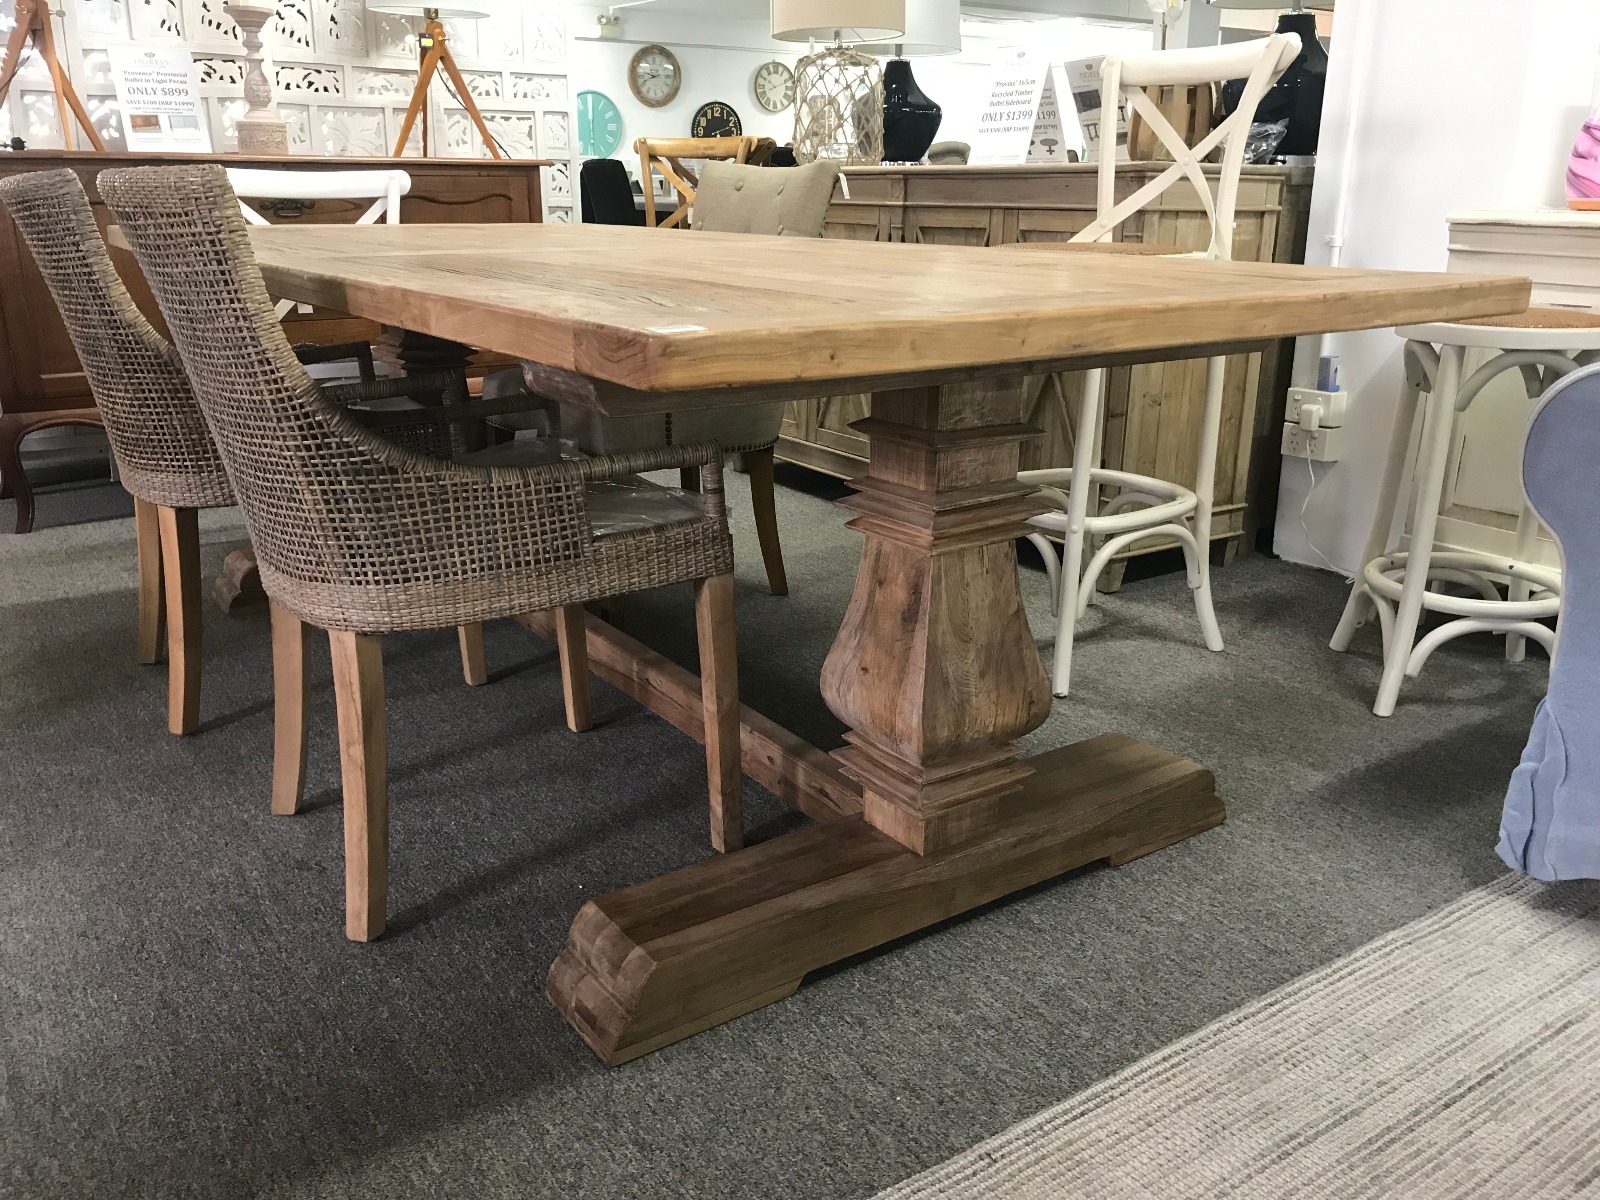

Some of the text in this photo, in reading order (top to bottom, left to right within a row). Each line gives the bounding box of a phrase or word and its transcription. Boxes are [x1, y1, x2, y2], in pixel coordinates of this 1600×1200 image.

[1078, 71, 1100, 79] TIGRES
[127, 87, 189, 96] ONLY $899
[1005, 98, 1032, 106] Sideboard
[706, 109, 712, 120] 11
[714, 107, 721, 117] 12
[723, 110, 727, 120] 1
[981, 110, 1033, 122] ONLY $1399
[1036, 110, 1056, 120] 1199
[699, 116, 706, 126] 10
[729, 117, 735, 127] 2
[698, 126, 704, 136] 9
[731, 127, 737, 136] 3
